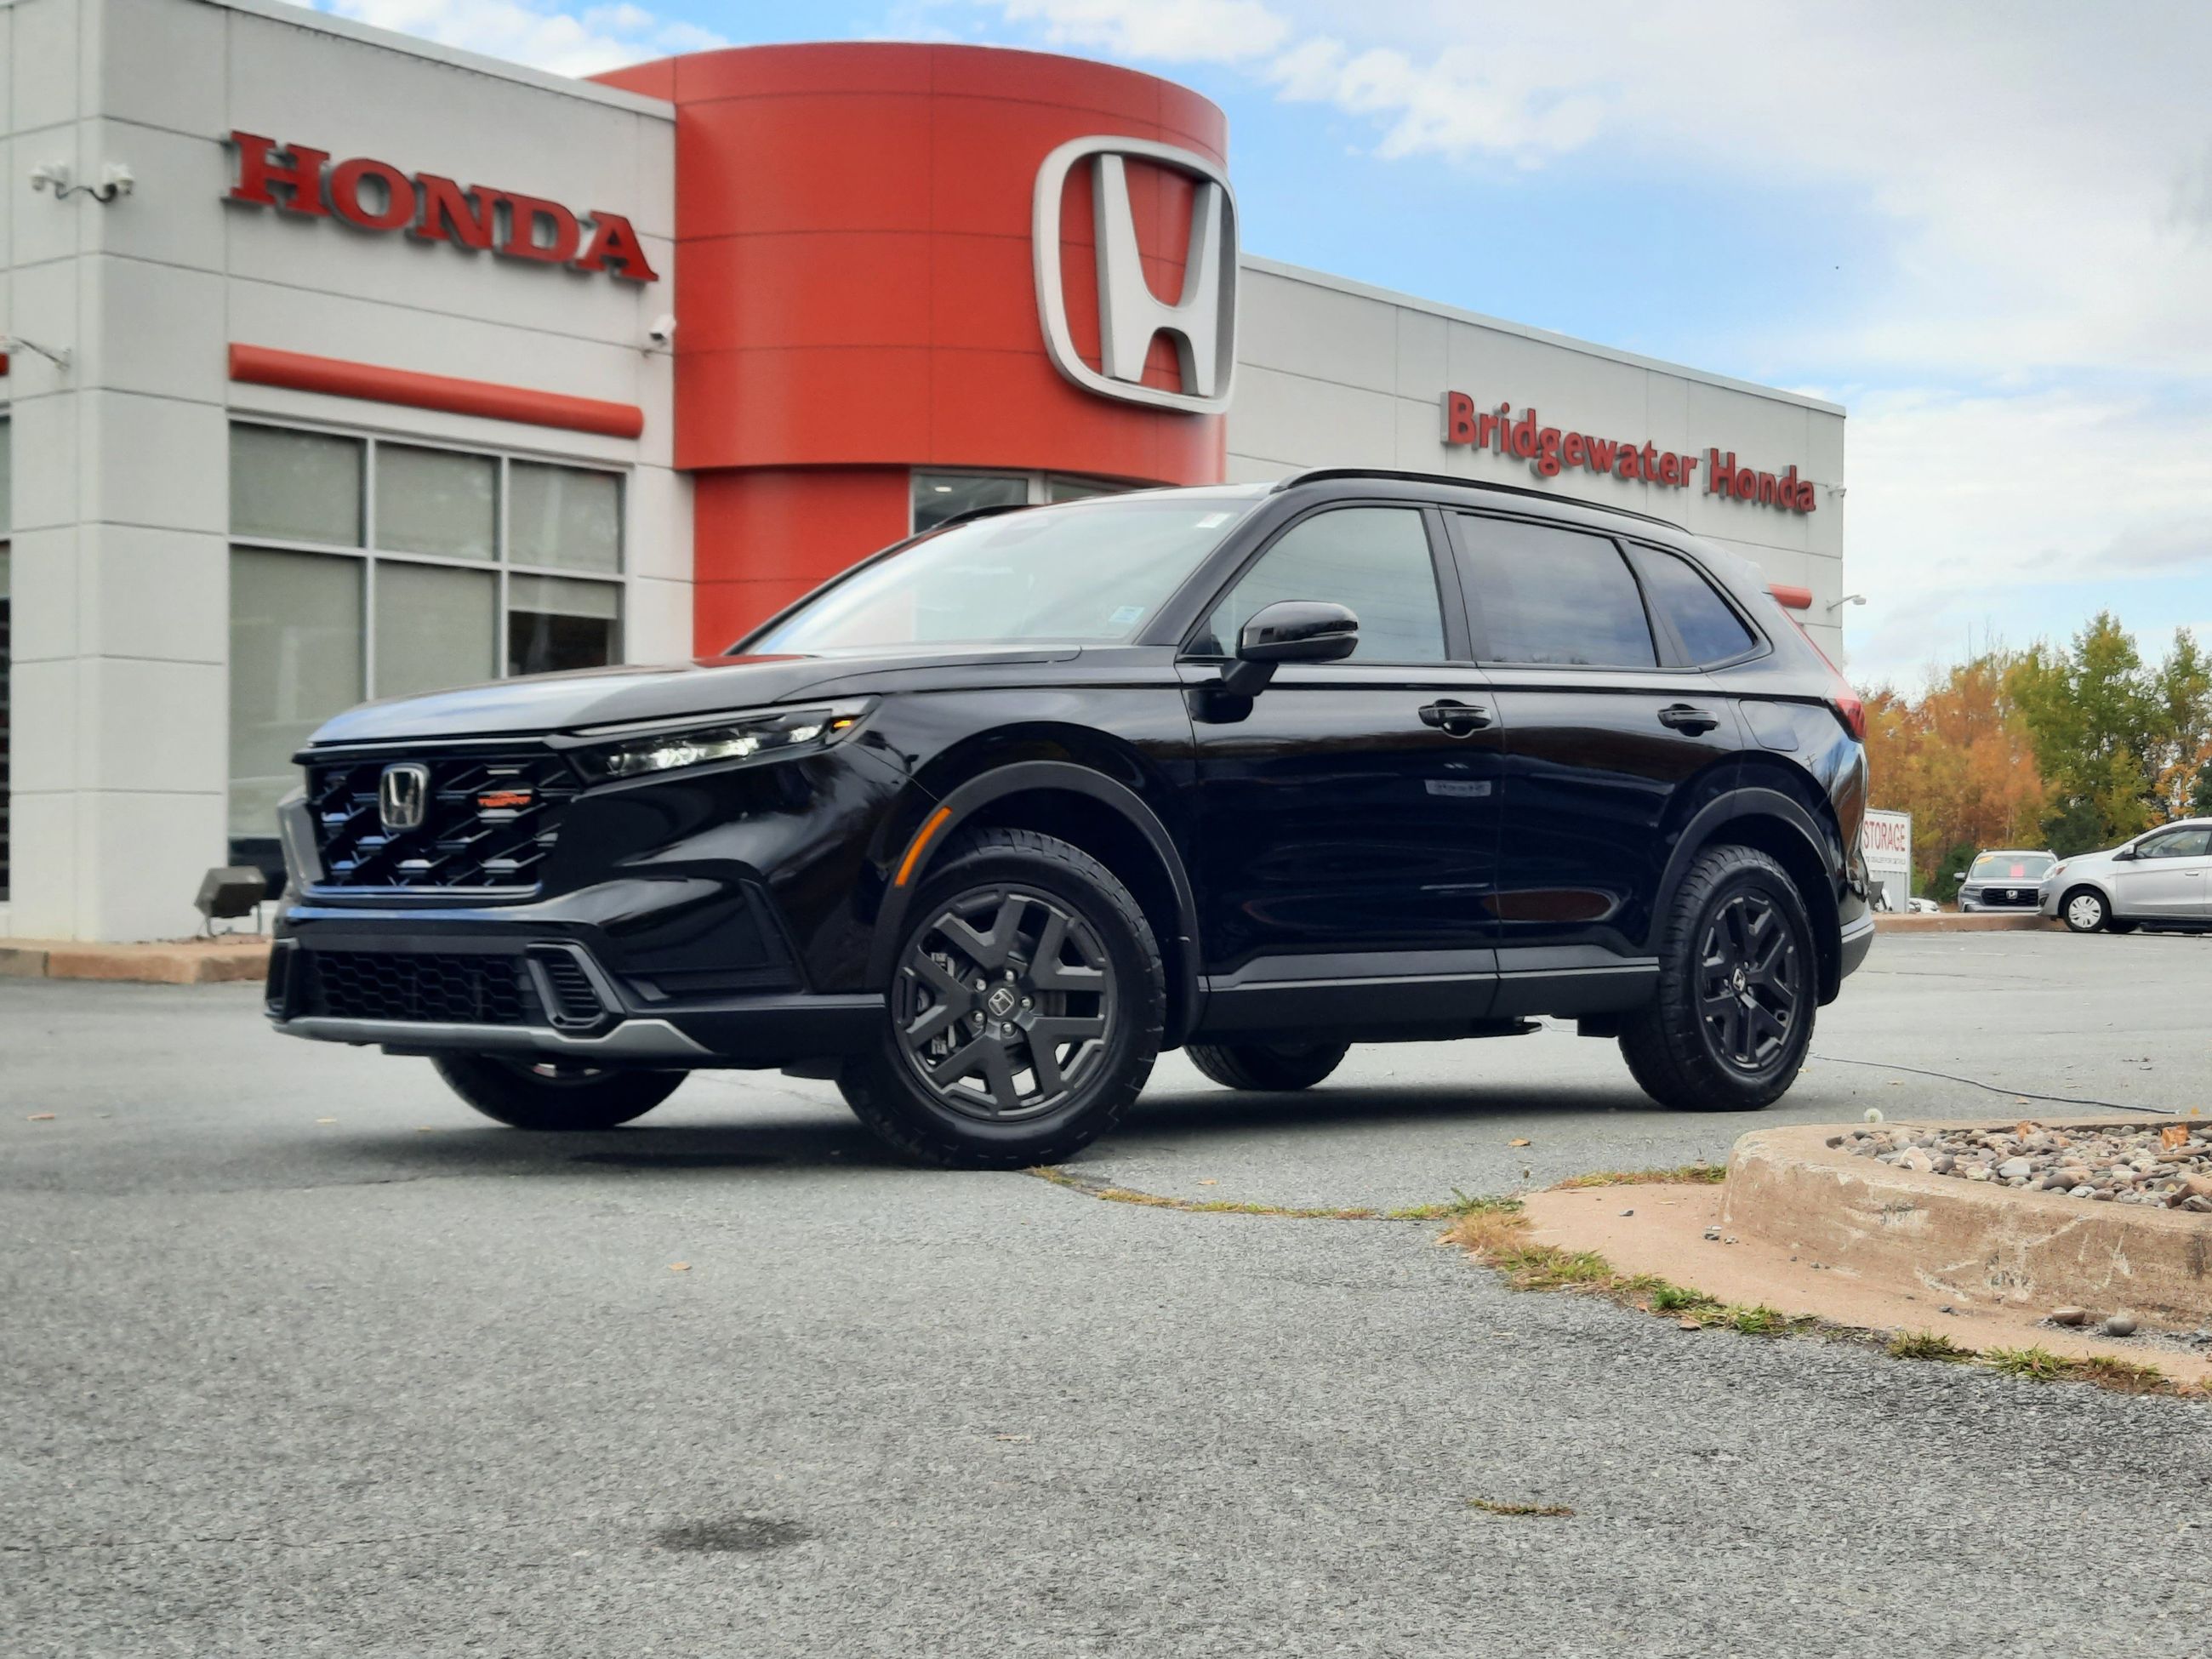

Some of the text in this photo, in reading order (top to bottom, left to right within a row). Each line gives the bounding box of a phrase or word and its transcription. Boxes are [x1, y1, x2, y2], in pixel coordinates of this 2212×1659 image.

[230, 129, 659, 282] HONDA
[1447, 390, 1816, 512] Bridgewater Honda
[1863, 820, 1906, 852] STORAGE
